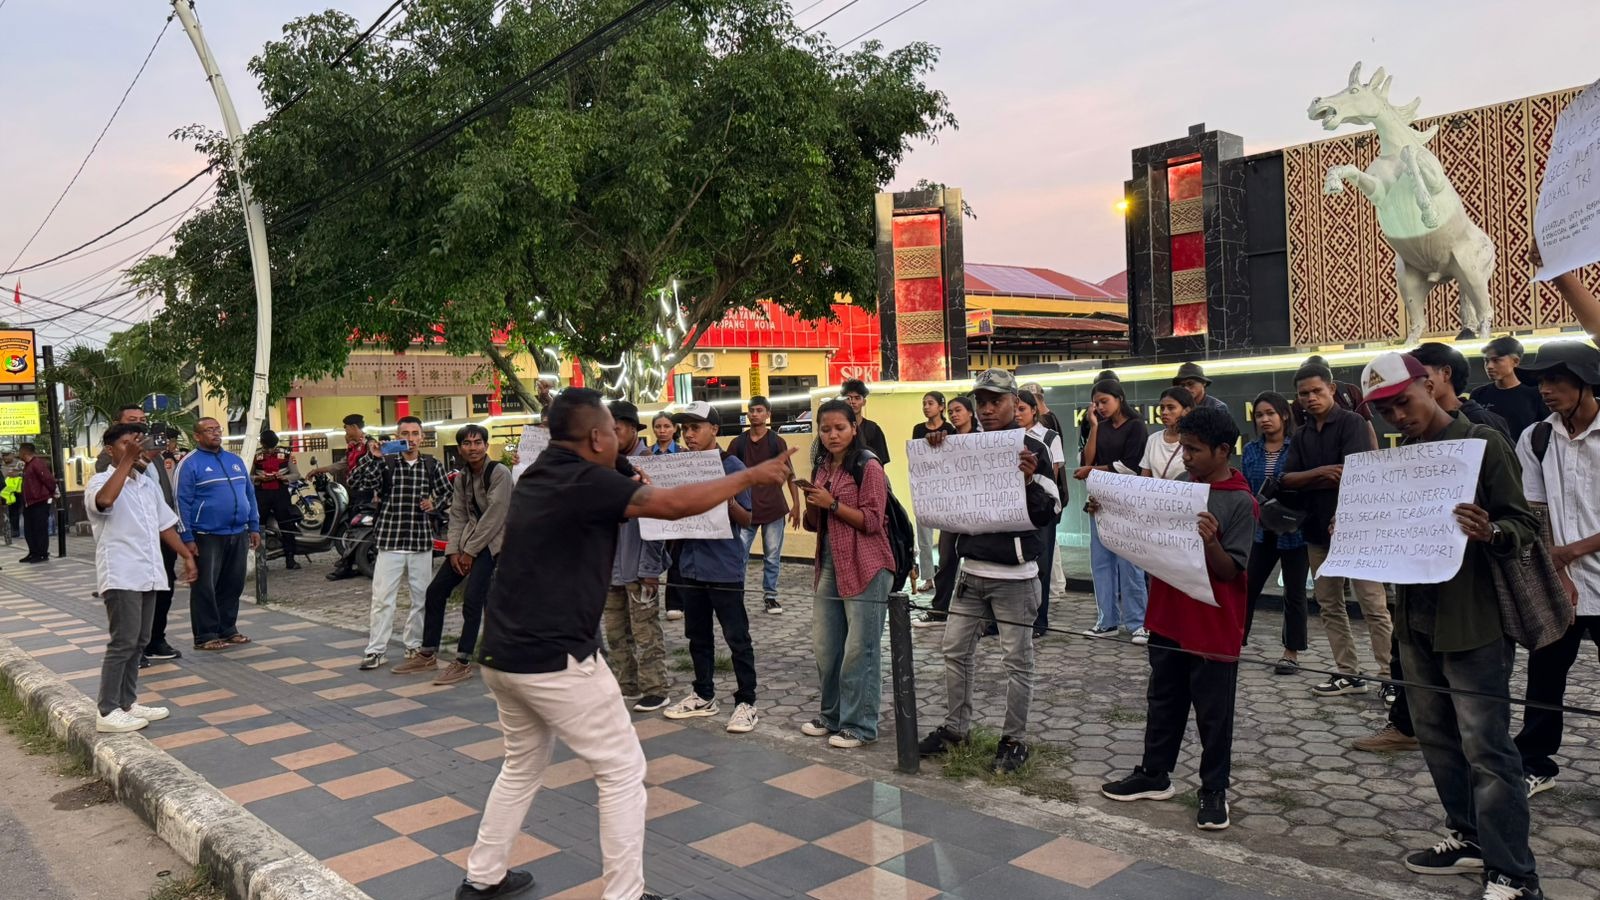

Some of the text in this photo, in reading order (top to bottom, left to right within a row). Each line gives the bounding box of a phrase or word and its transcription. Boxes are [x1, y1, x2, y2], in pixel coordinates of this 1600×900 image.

[1576, 168, 1592, 190] TKP
[754, 321, 775, 330] KOTA
[975, 429, 1017, 451] POLRES
[1398, 441, 1465, 464] POLRESTA
[910, 458, 951, 478] KUPANG
[953, 455, 982, 473] KOTA
[1381, 469, 1408, 486] KOTA
[1412, 463, 1457, 480] SEGERA
[911, 471, 1021, 497] MEMPERCEPAT PROSES
[1092, 470, 1194, 498] MENDESAK POLRESTA
[914, 491, 1020, 514] PENYIDIKAN TERHADAP
[1123, 493, 1148, 510] KOTA
[1153, 498, 1194, 515] SEGERA
[1400, 485, 1465, 506] KONFERENSI
[944, 510, 992, 527] KEMATIAN
[998, 508, 1025, 523] YERDI
[1101, 502, 1160, 527] ENGHADIRKAN
[1358, 511, 1392, 523] SECARA
[1397, 505, 1444, 521] TERBUKA
[1096, 518, 1200, 552] KUNCI UNTUK DIMINTA
[1375, 525, 1455, 542] PERKEMBANGAN
[1331, 543, 1455, 559] KASUS KEMATIAN SAUDARI
